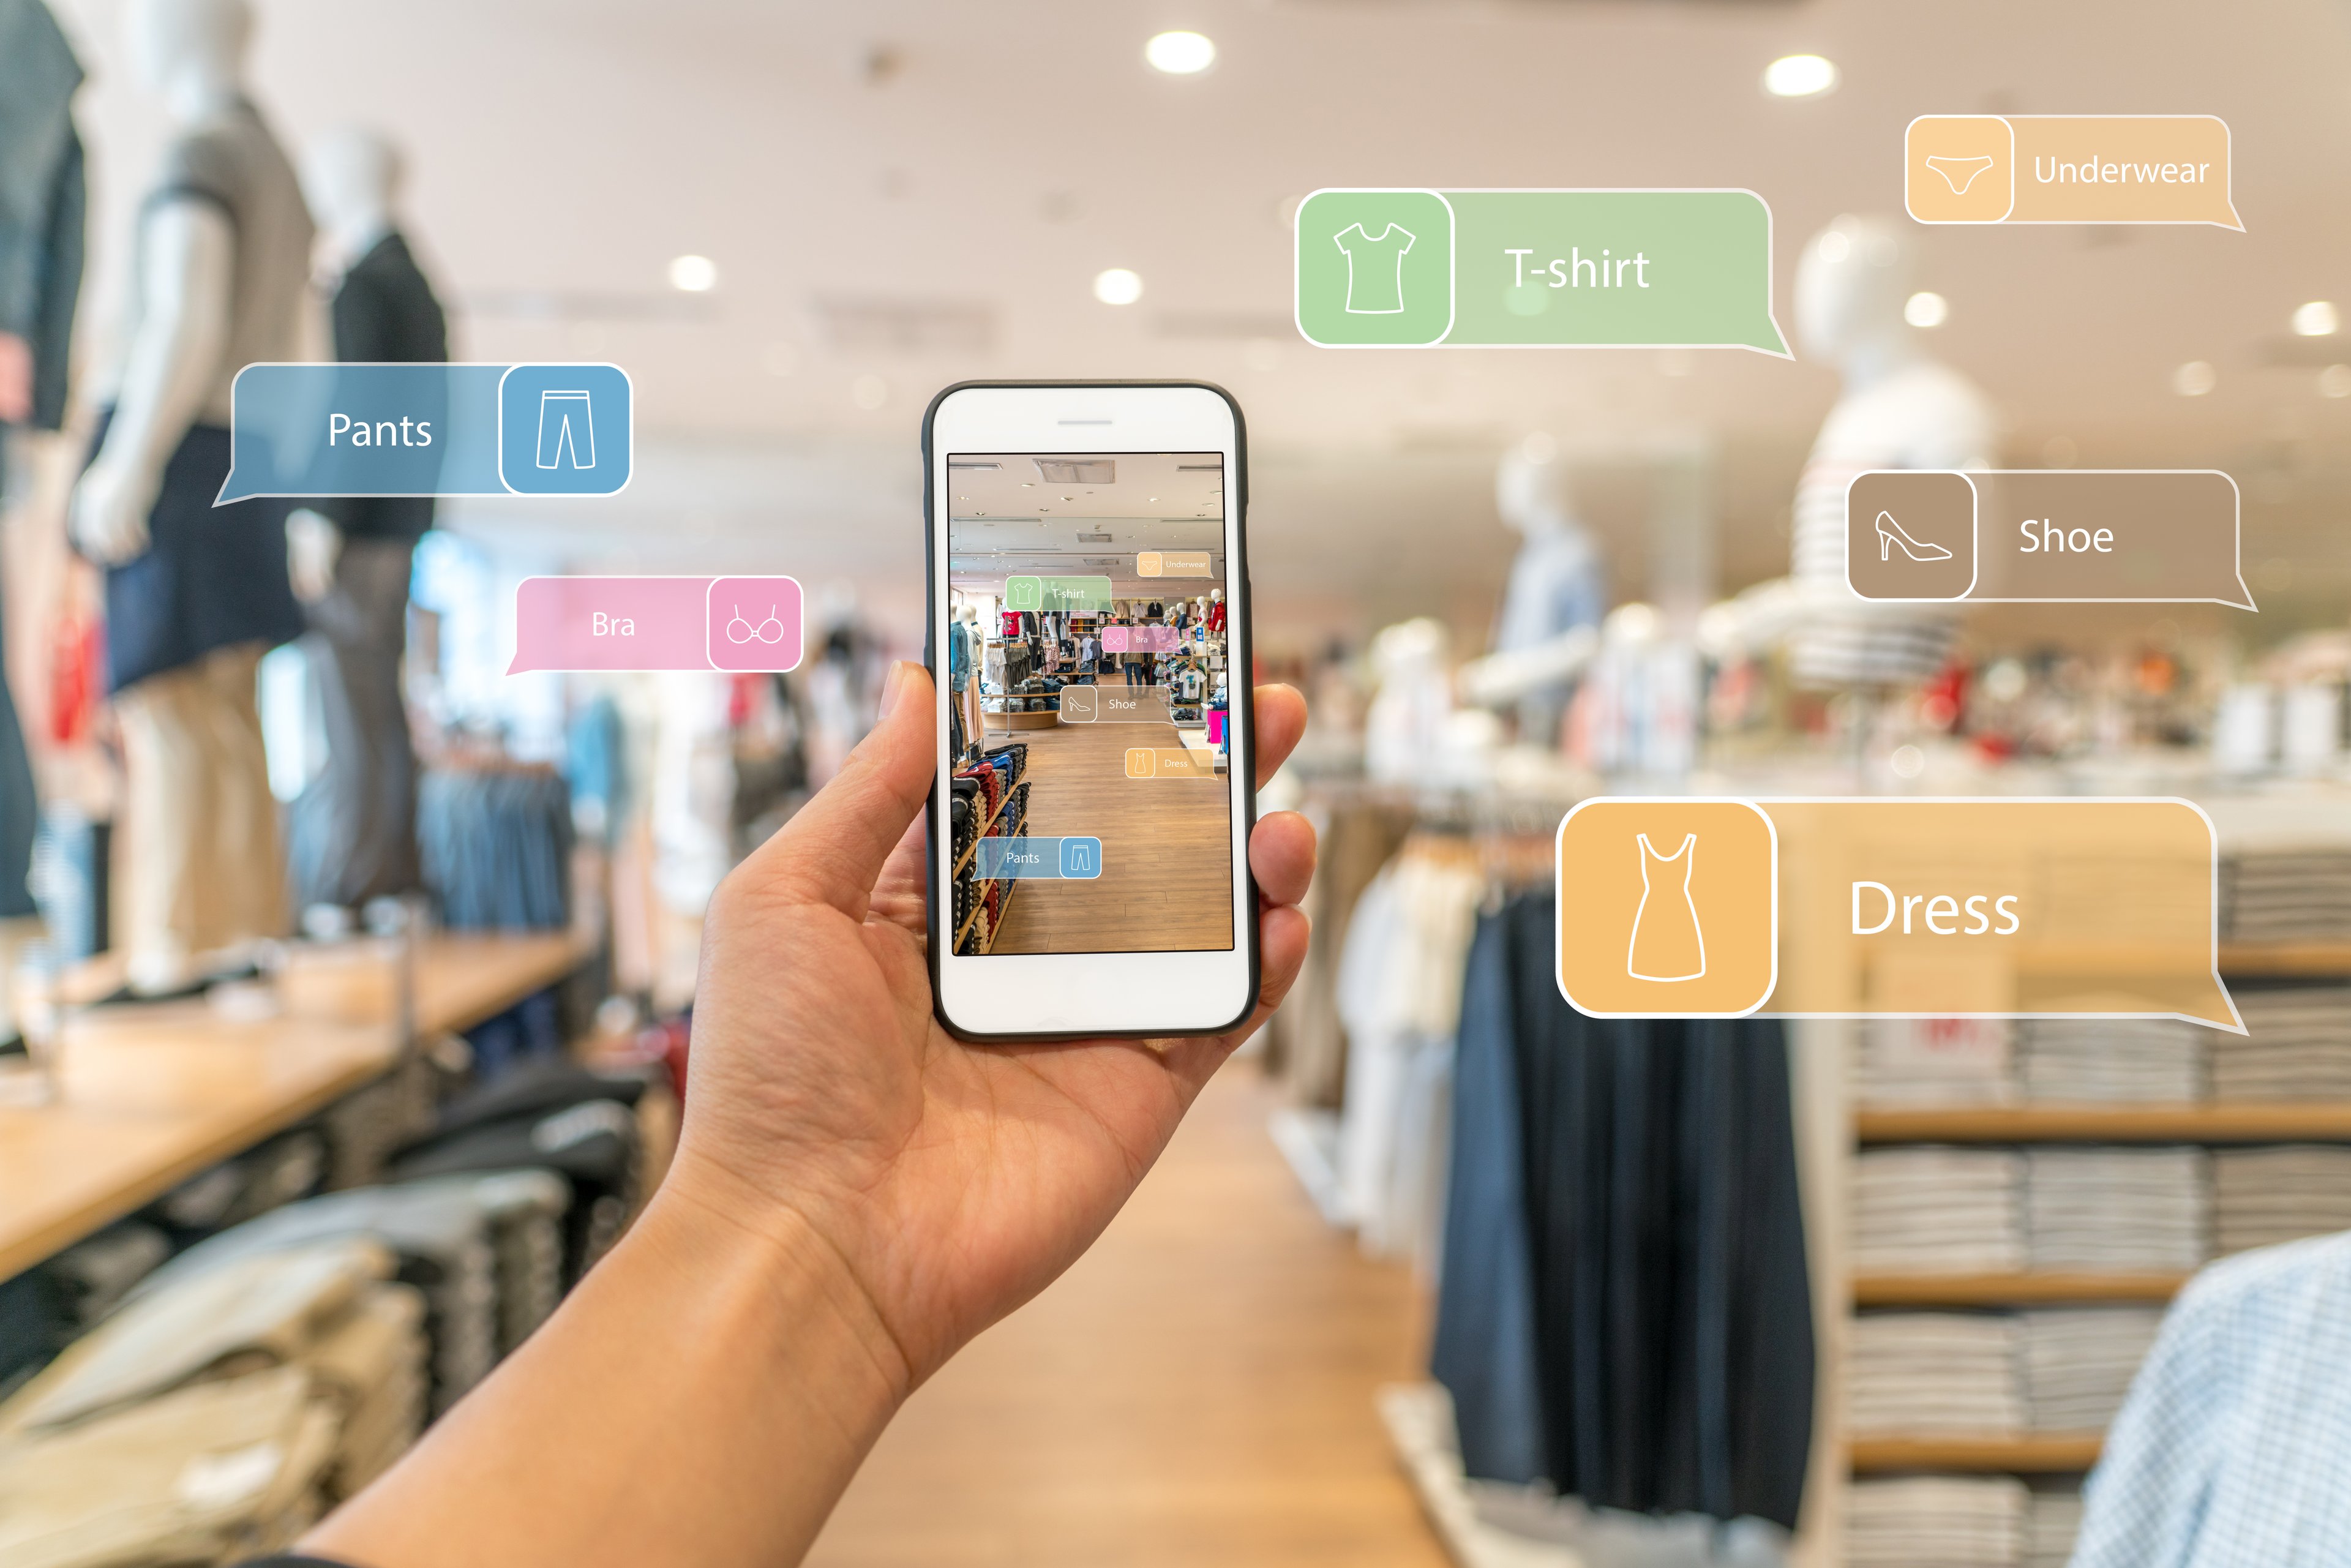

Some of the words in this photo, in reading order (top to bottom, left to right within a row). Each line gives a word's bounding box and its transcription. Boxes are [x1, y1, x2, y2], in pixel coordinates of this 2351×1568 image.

[1051, 588, 1085, 598] T-shirt
[1108, 699, 1136, 709] Shoe
[1164, 759, 1188, 768] Dress
[1006, 852, 1040, 863] Pants
